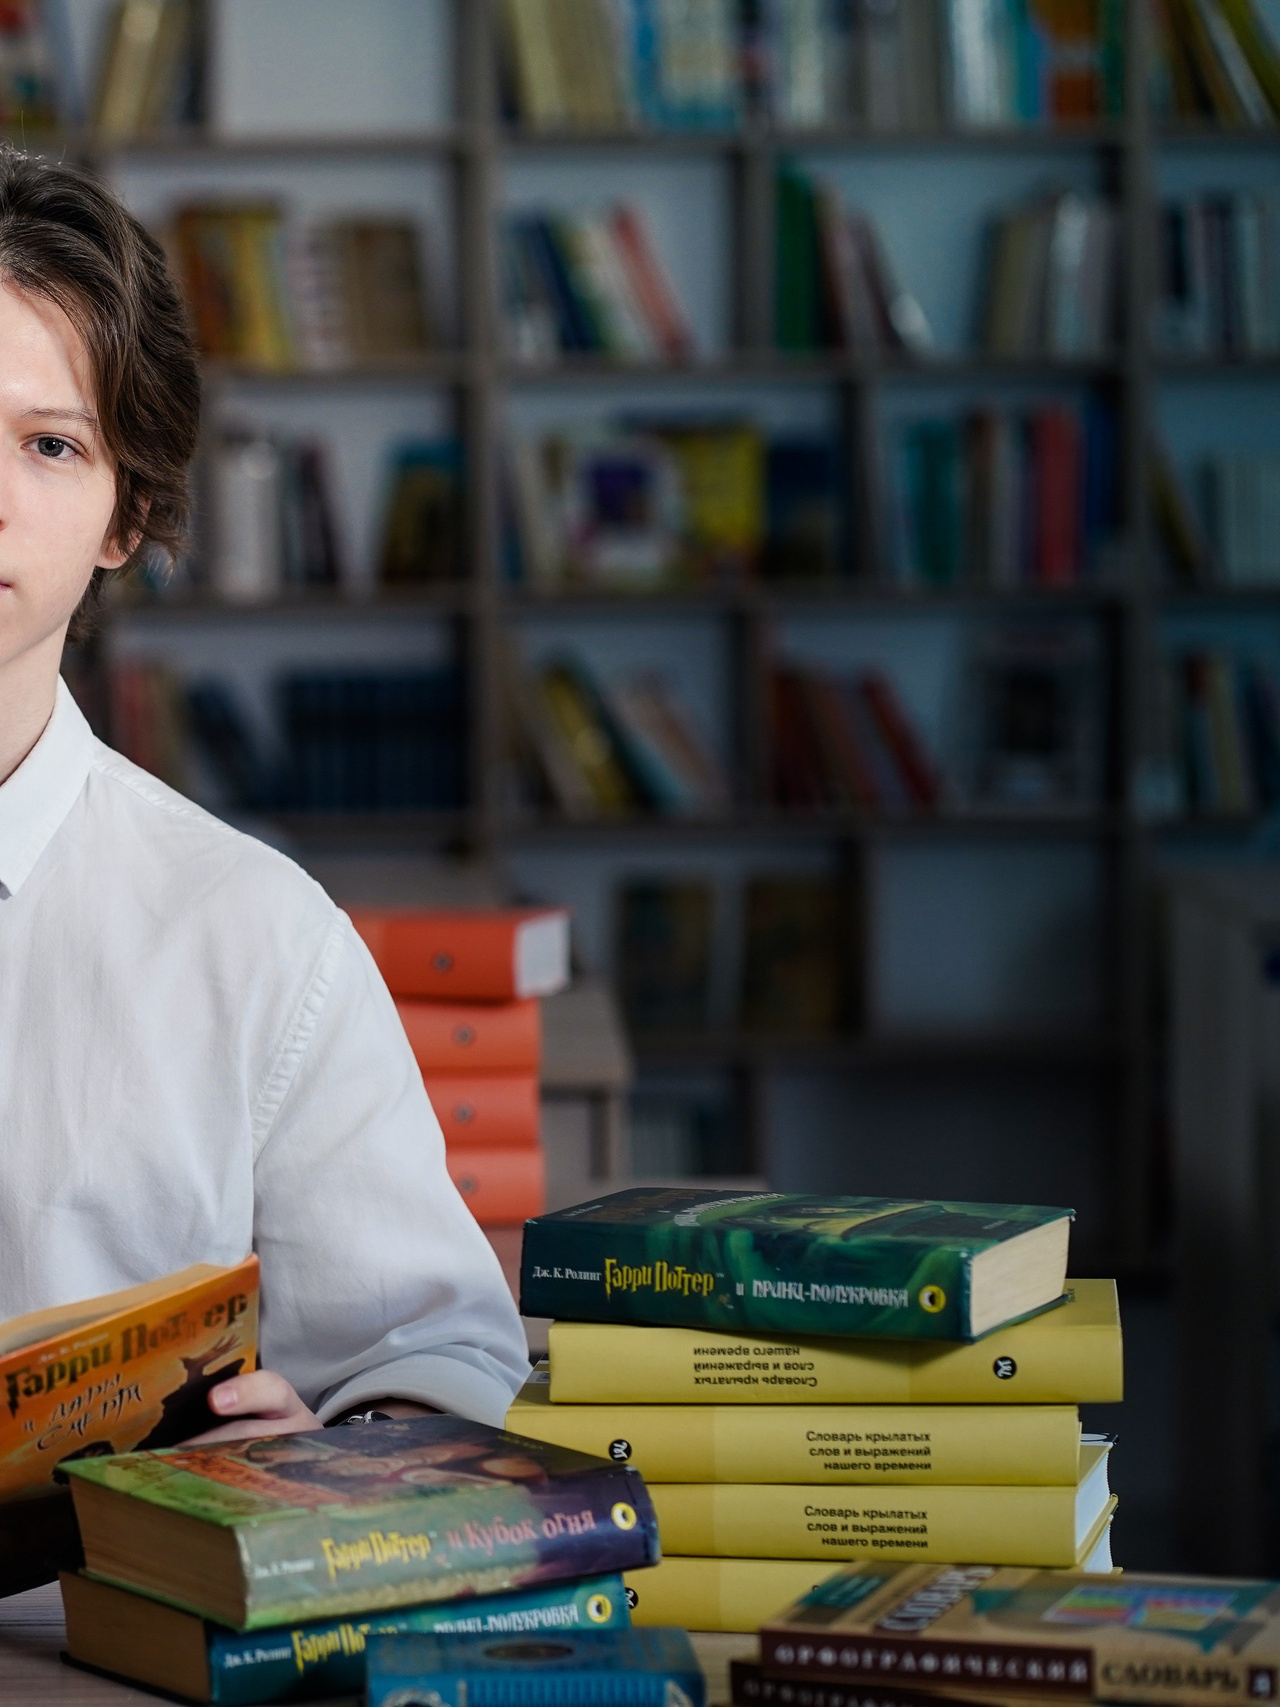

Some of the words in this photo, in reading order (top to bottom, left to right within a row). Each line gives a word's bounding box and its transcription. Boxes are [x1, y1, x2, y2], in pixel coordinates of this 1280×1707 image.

[564, 1268, 602, 1282] Ролинг
[604, 1258, 652, 1301] Гарри
[735, 1281, 745, 1296] и
[693, 1345, 750, 1356] времени
[753, 1346, 800, 1356] нашего
[693, 1360, 770, 1372] выражений
[773, 1362, 780, 1370] и
[784, 1362, 815, 1371] слов
[693, 1374, 759, 1385] крылатых
[762, 1374, 818, 1387] Словарь
[806, 1430, 863, 1444] Словарь
[865, 1432, 931, 1444] крылатых
[809, 1447, 841, 1456] слов
[844, 1448, 851, 1456] и
[855, 1446, 931, 1458] выражений
[824, 1461, 871, 1470] нашего
[874, 1462, 931, 1472] времени
[804, 1505, 860, 1520] Словарь
[863, 1508, 928, 1521] крылатых
[464, 1515, 539, 1557] Кубок
[541, 1509, 597, 1539] огня
[807, 1522, 838, 1532] слов
[841, 1523, 849, 1532] и
[852, 1523, 928, 1535] выражений
[821, 1537, 869, 1547] нашего
[871, 1538, 928, 1549] времени
